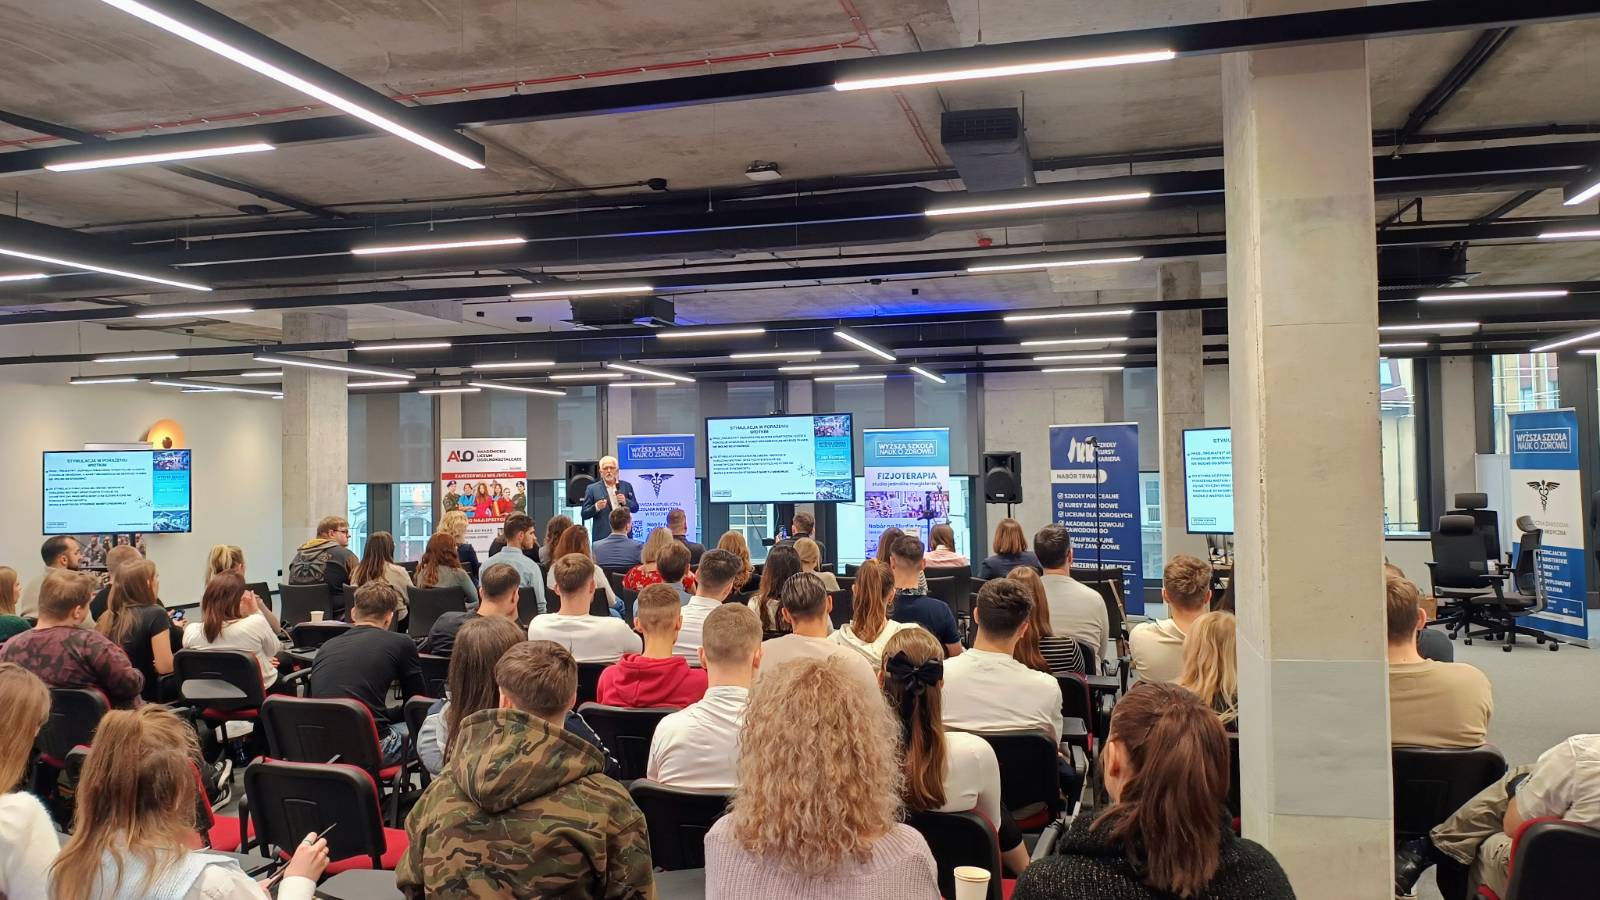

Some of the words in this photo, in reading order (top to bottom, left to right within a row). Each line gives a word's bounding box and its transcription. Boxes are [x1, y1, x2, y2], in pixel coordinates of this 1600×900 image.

[1516, 432, 1541, 442] WYŻSZA
[1542, 432, 1568, 441] SZKOŁA
[631, 445, 656, 453] WYŻSZA
[1517, 442, 1533, 450] NAUK
[1540, 441, 1568, 450] ZDROWIU
[447, 450, 475, 463] ALO
[877, 472, 937, 480] FIZJOTERAPIA
